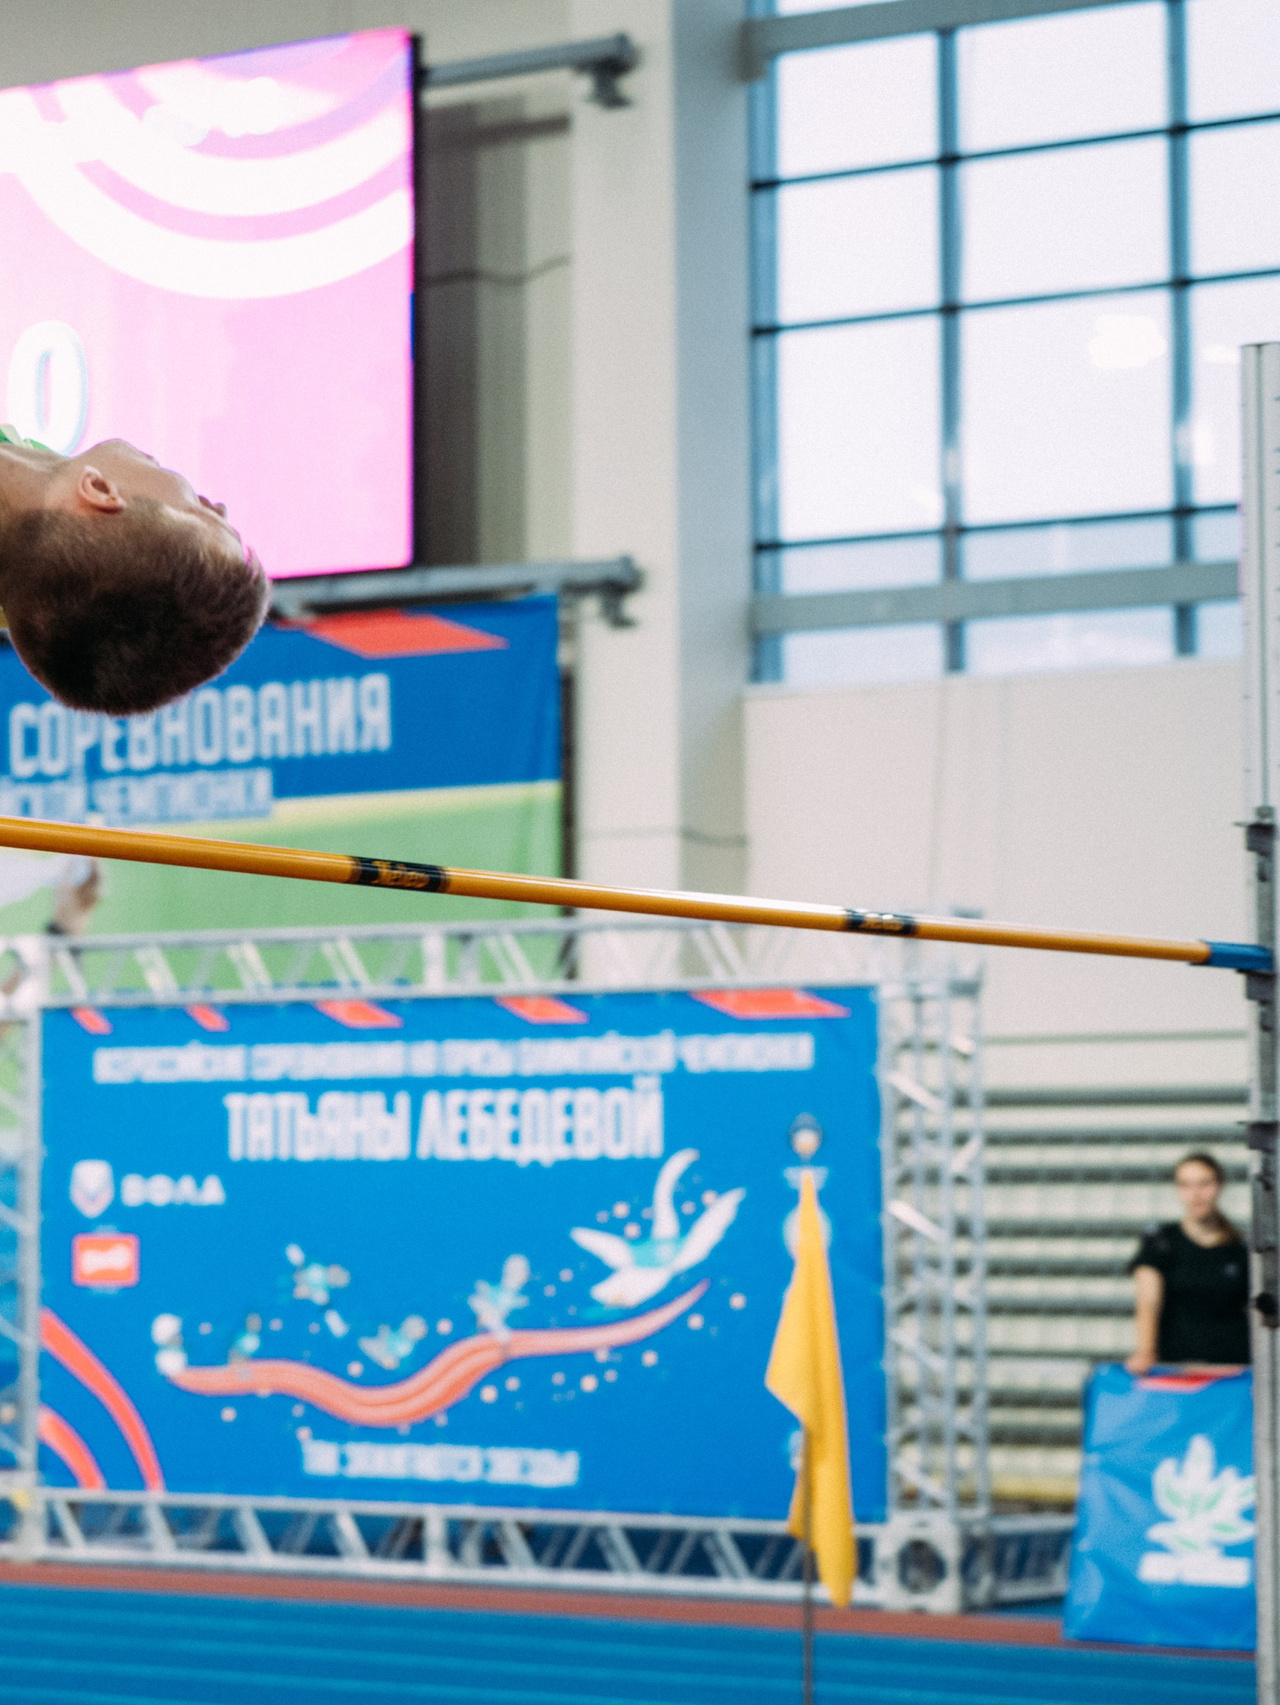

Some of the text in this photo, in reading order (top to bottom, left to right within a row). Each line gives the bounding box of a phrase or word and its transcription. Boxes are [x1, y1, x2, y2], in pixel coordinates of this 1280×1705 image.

[9, 672, 392, 779] СОРЕВНОВАНИЯ
[222, 1075, 665, 1168] ТАТЬЯНЫ ЛЕБЕДЕВОЙ
